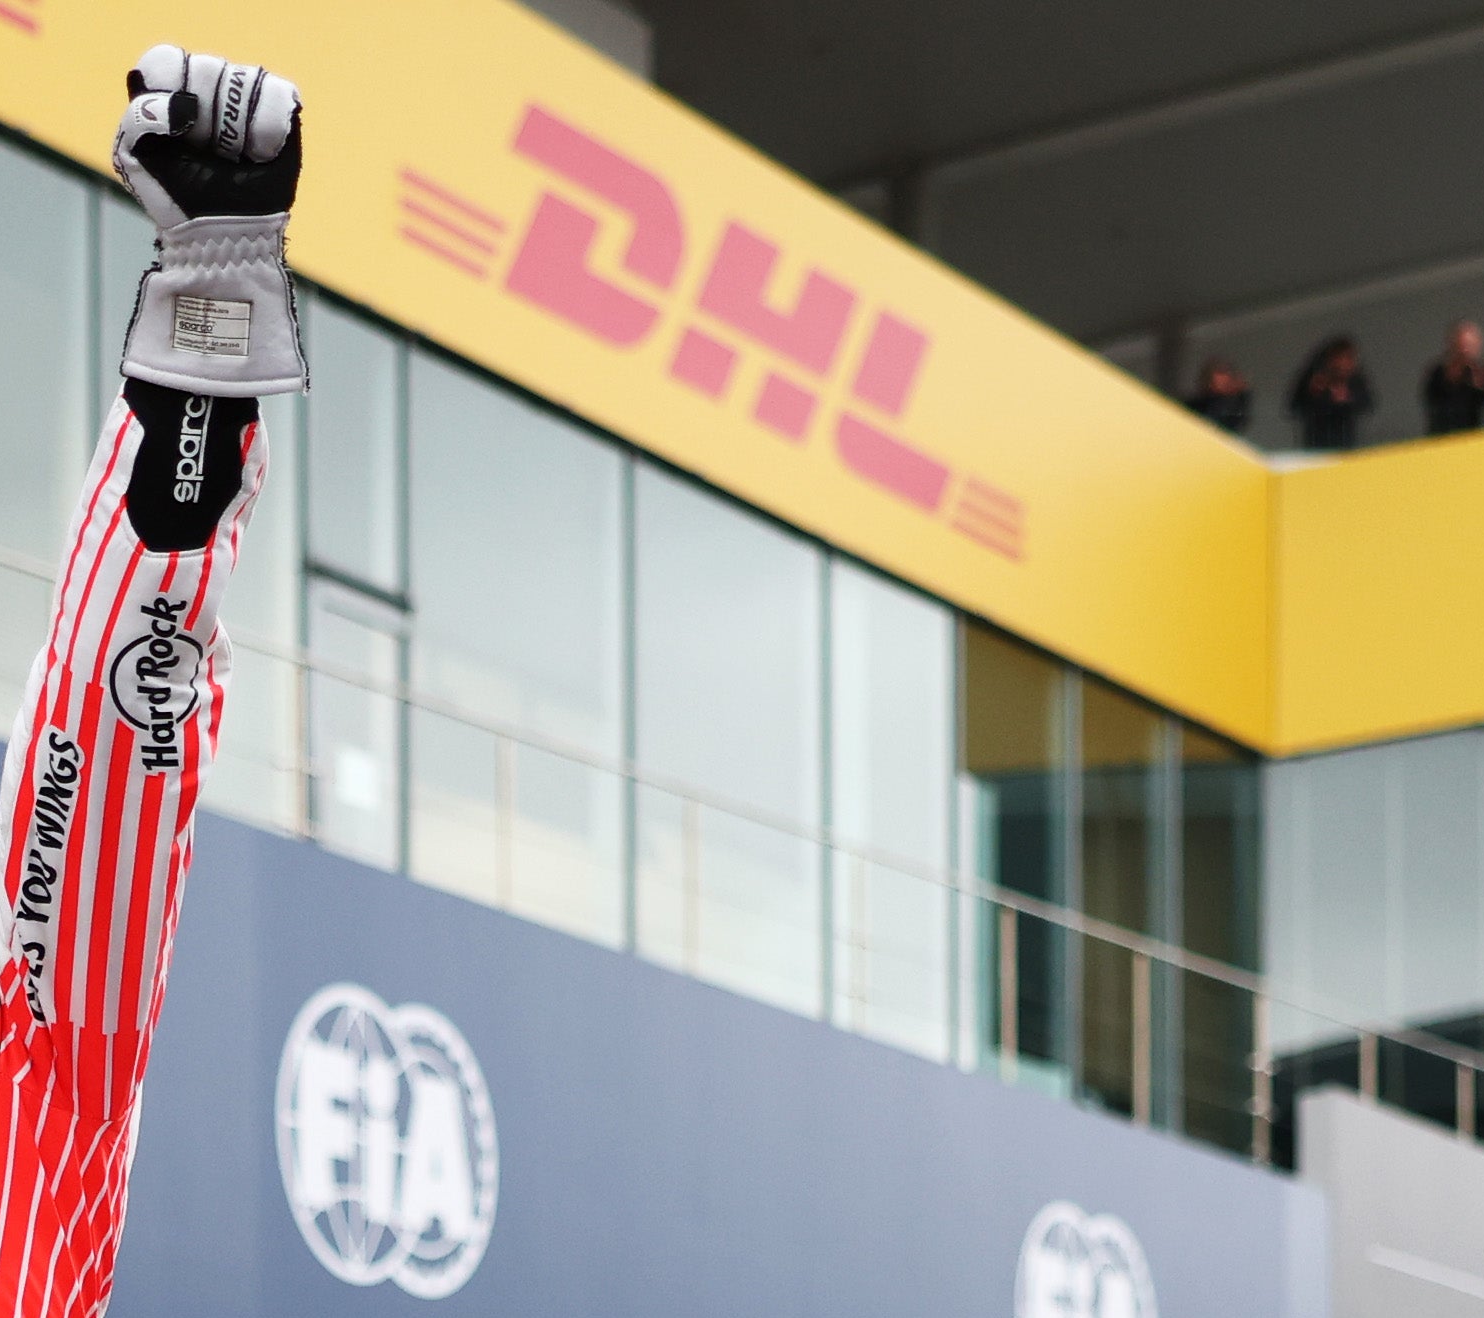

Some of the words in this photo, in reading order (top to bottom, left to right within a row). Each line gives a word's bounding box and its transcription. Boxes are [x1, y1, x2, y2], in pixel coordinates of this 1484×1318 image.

[500, 104, 952, 518] DHL
[173, 396, 209, 503] sparc
[135, 598, 186, 682] Rock
[136, 686, 180, 770] Hard
[27, 731, 81, 850] WINGS
[16, 848, 58, 925] YOU
[296, 1038, 477, 1245] FIA
